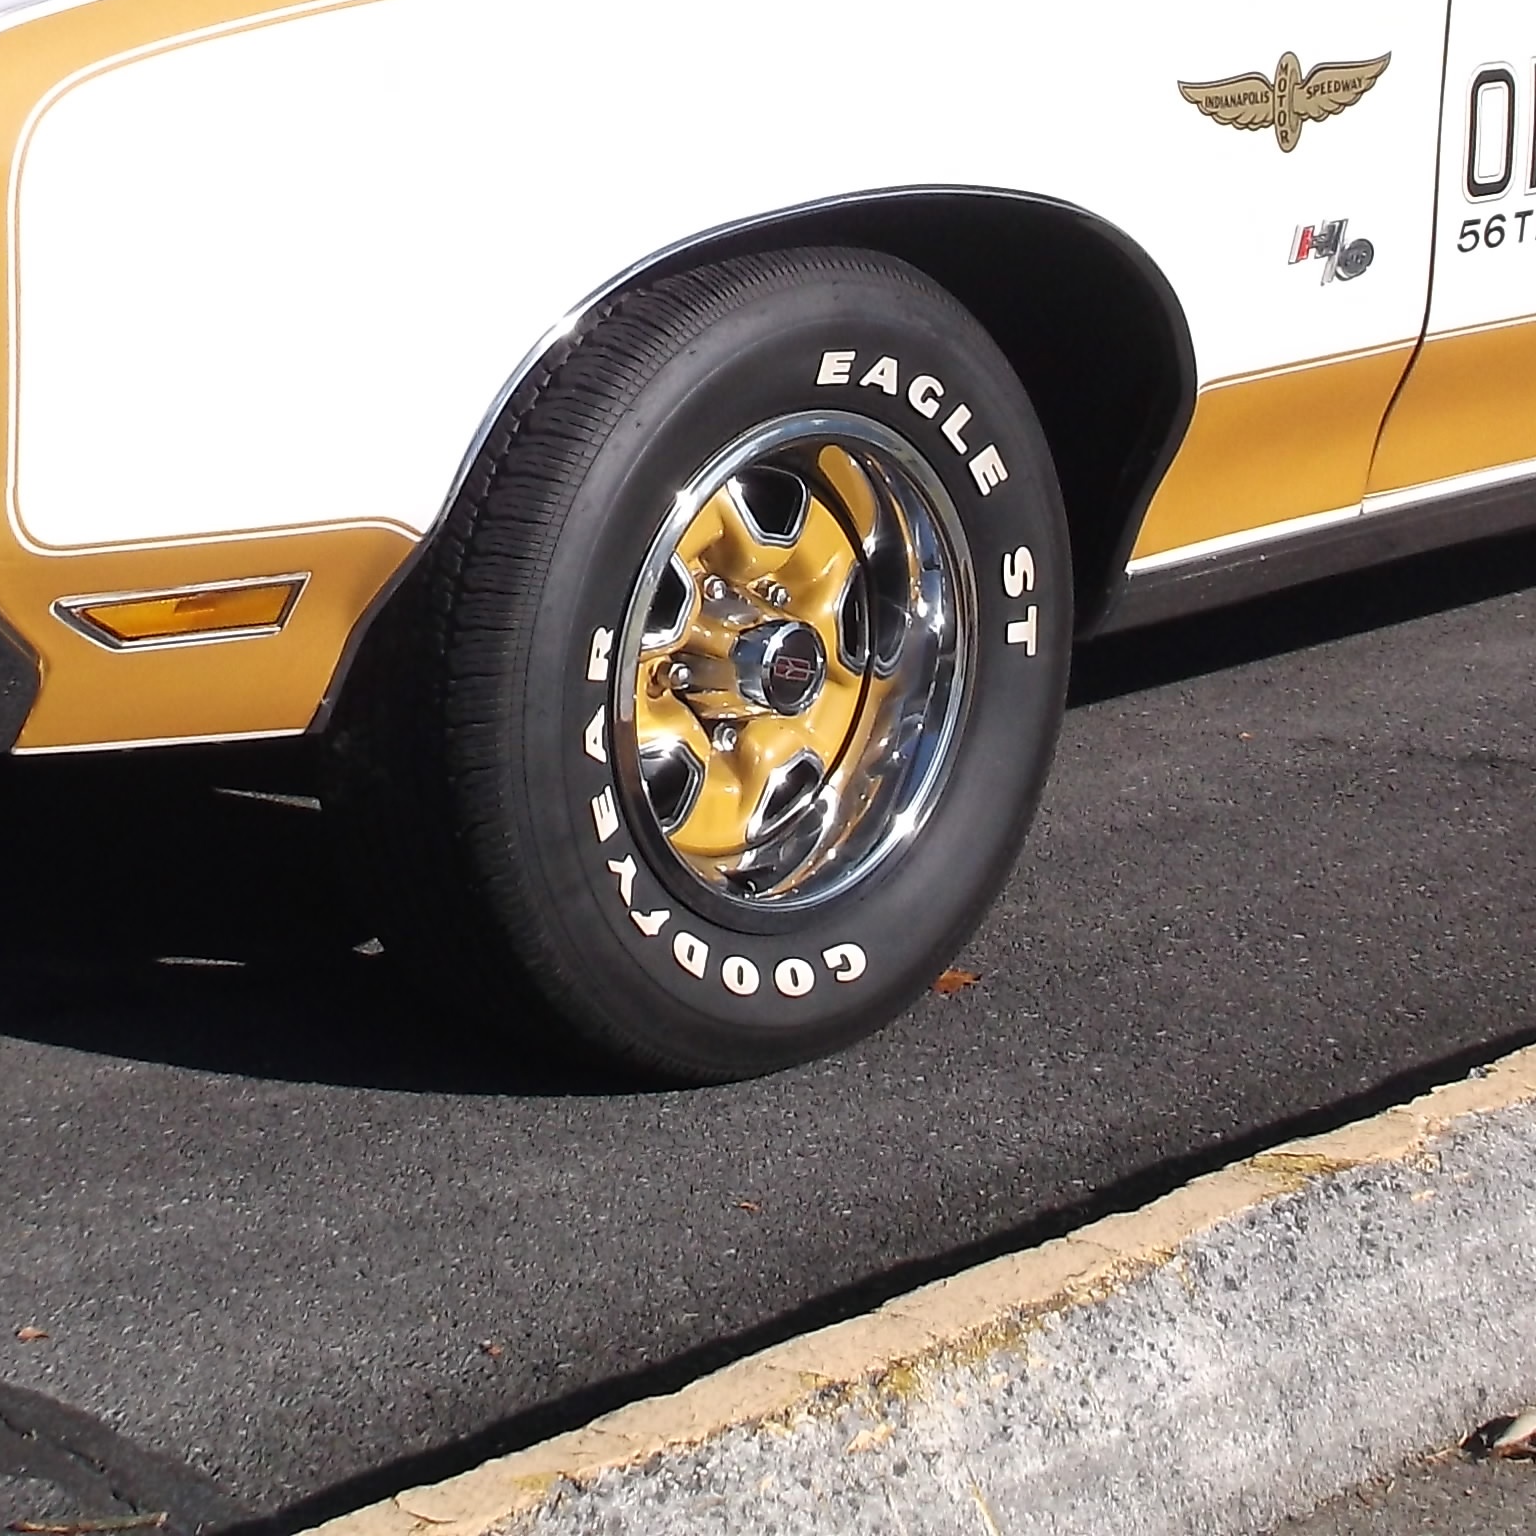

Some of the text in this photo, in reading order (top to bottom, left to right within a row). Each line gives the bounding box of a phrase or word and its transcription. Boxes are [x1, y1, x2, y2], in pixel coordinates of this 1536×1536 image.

[1204, 62, 1364, 144] INDIANAPOLIS MOTOR SPEEDWAY
[816, 350, 1037, 657] EAGLE ST
[584, 625, 868, 996] GOODYEAR
